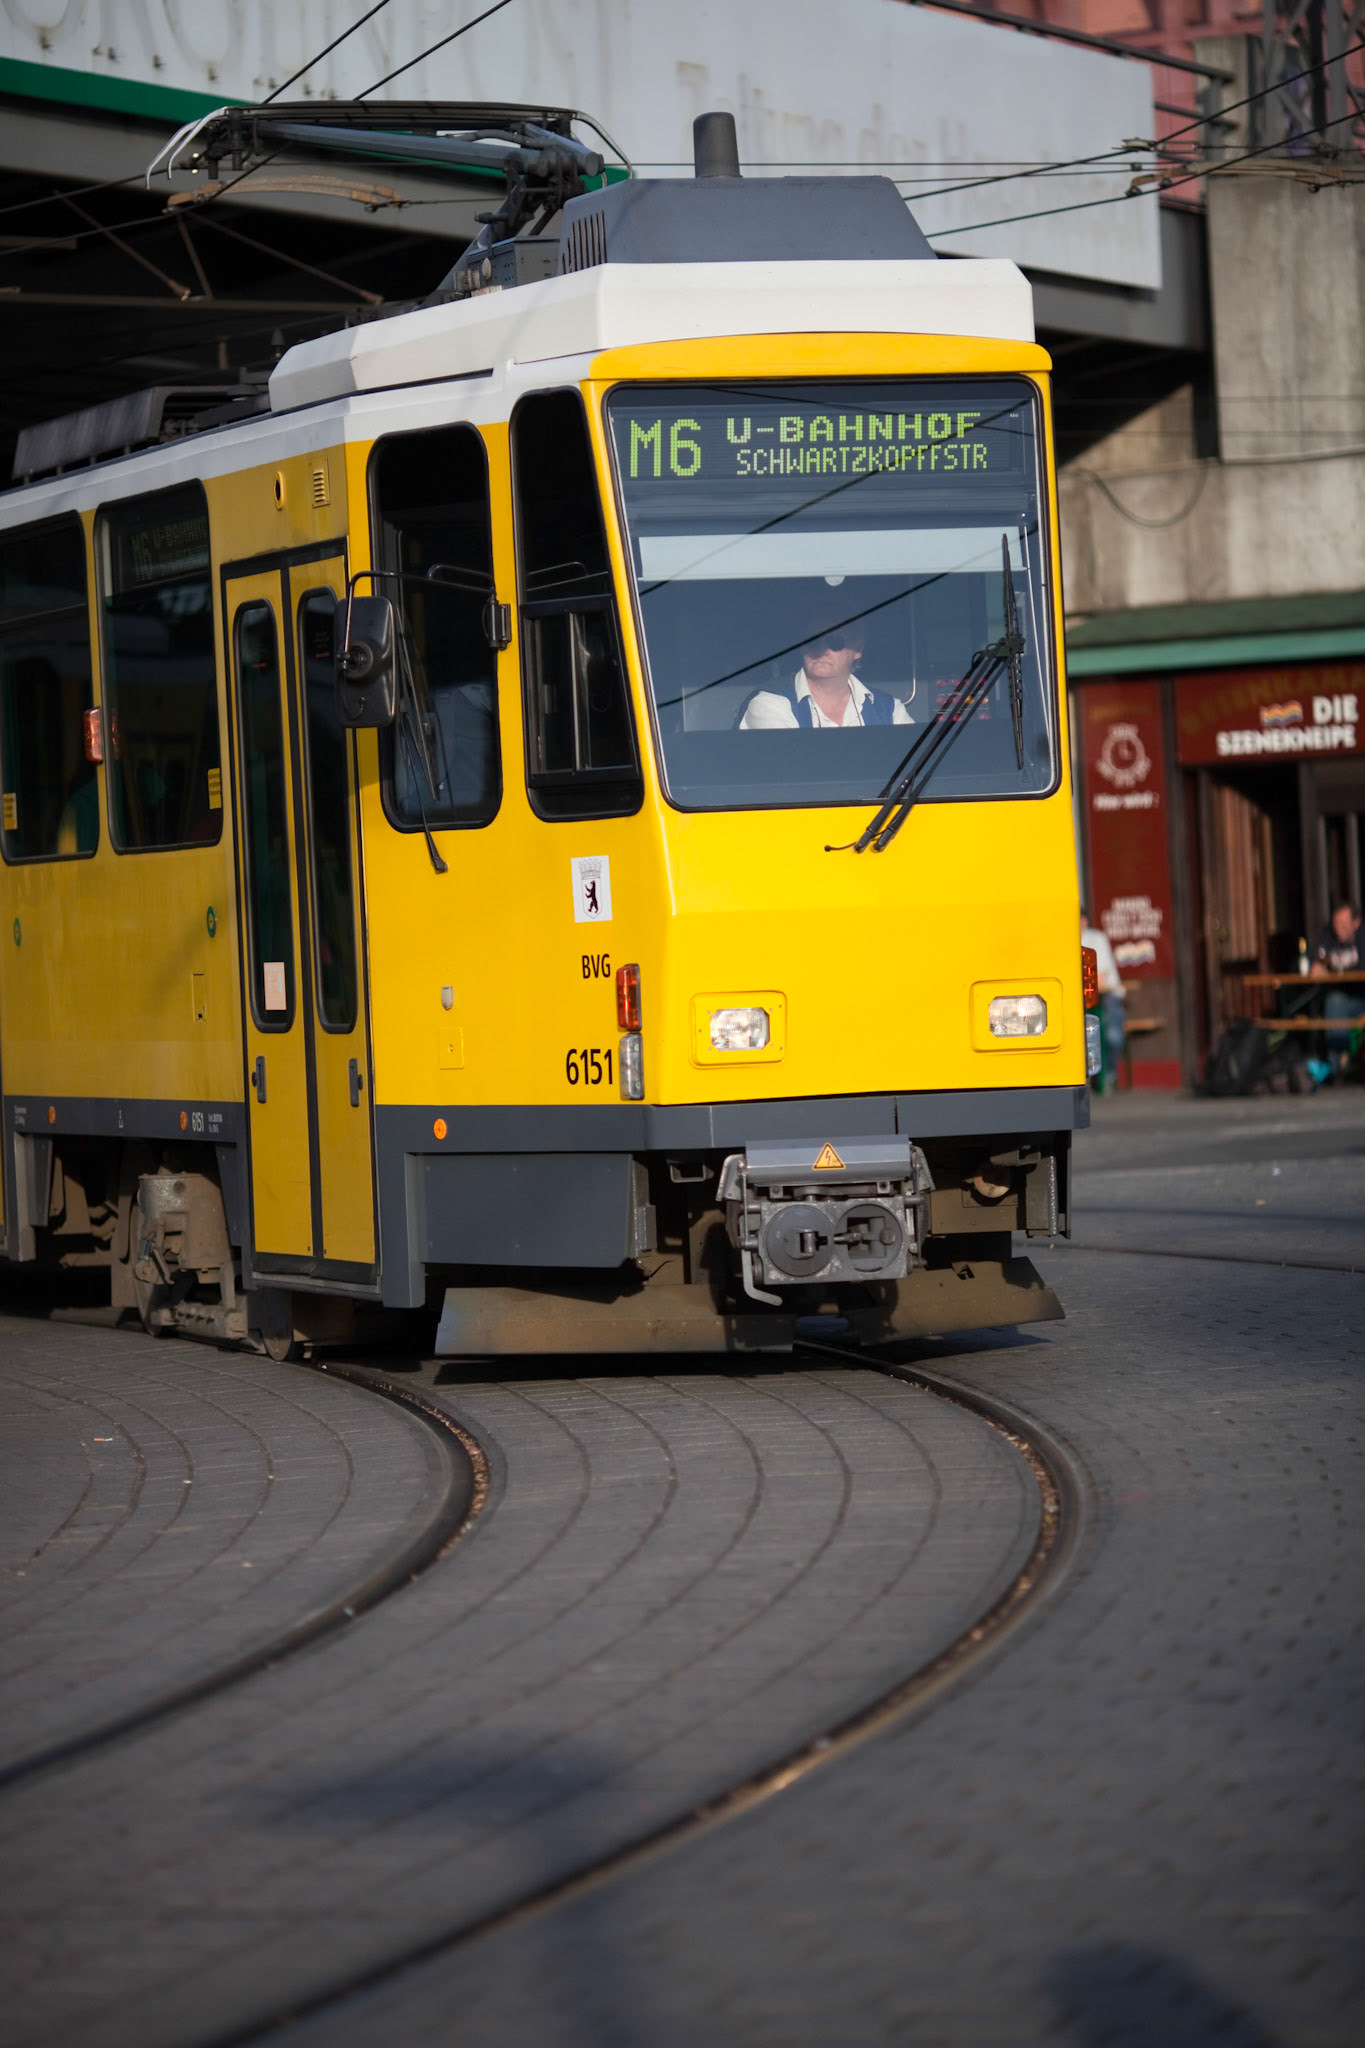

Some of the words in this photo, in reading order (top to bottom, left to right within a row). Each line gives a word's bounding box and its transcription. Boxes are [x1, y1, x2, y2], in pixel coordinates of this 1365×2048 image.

[727, 412, 981, 443] U-BAHNHOF
[630, 419, 701, 477] M6
[736, 443, 987, 475] SCHWARTZKOPFFSTR
[1313, 694, 1359, 724] DIE
[1216, 725, 1357, 756] SZENEKNEIPE
[581, 953, 611, 979] BVG
[566, 1048, 613, 1085] 6151
[191, 1111, 205, 1133] 6151
